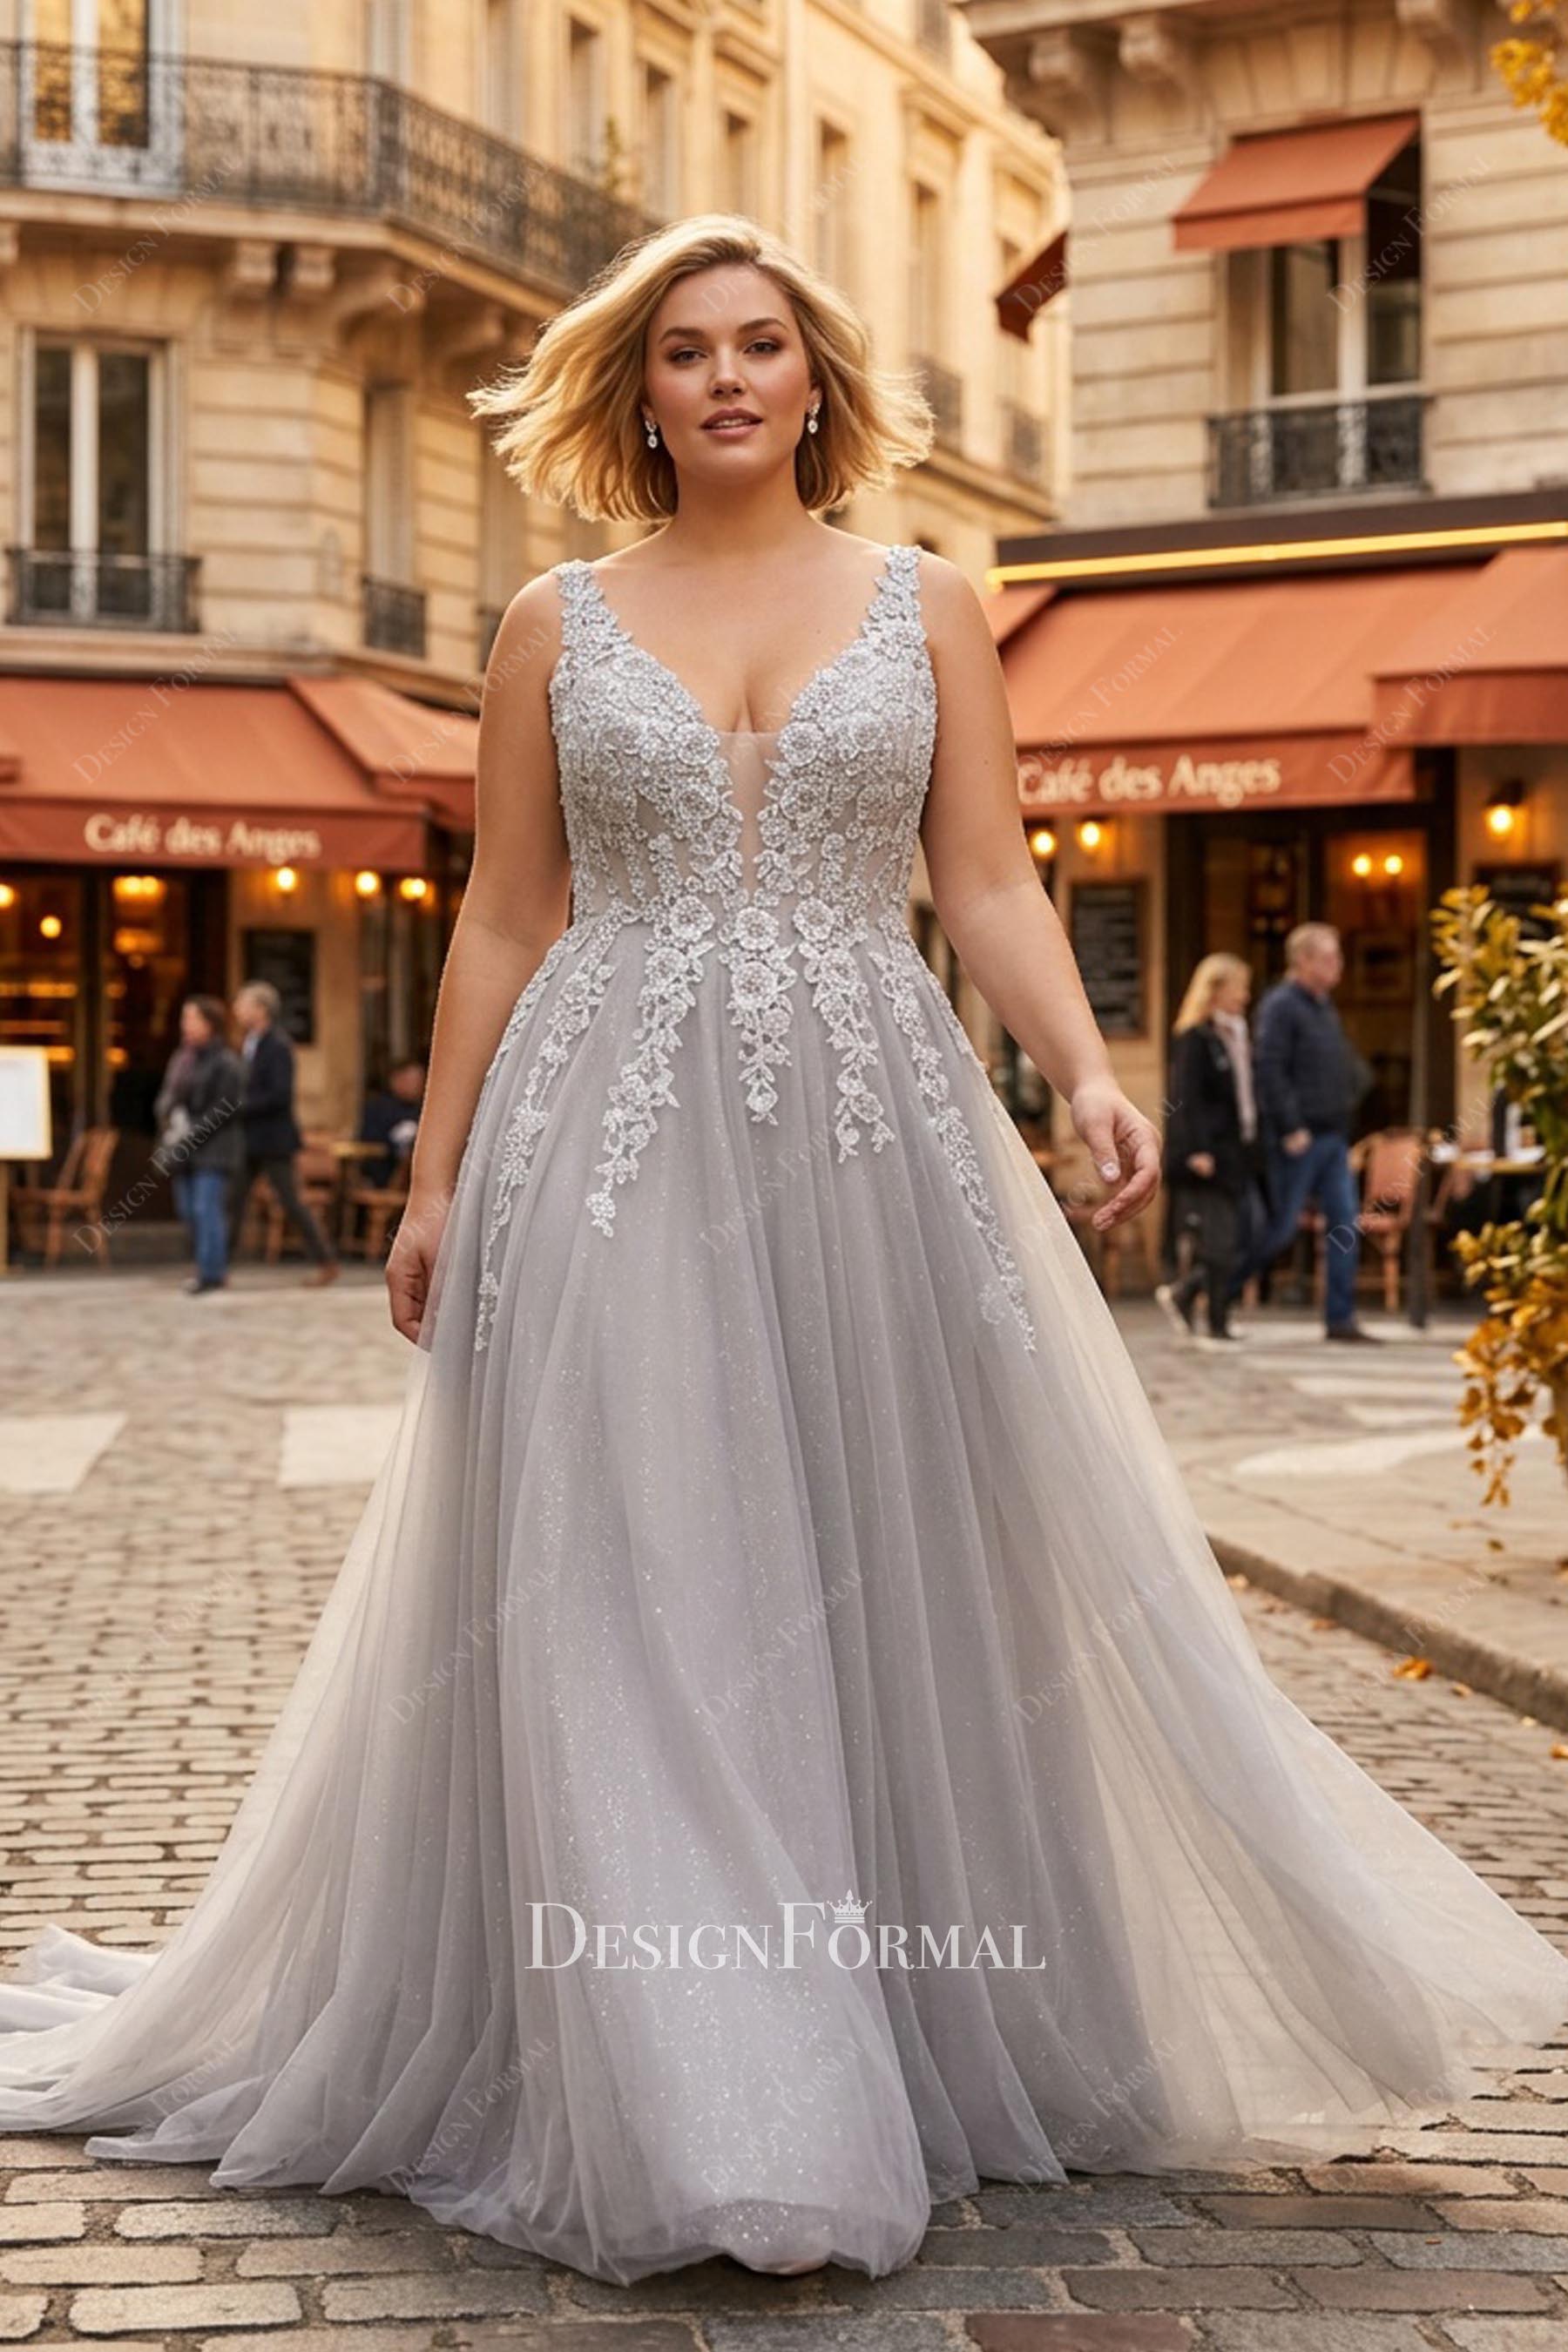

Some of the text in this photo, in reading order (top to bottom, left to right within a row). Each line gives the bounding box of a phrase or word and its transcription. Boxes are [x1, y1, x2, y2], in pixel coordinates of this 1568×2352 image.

[1017, 754, 1281, 808] Café des Anges
[84, 813, 322, 865] Café des Anges
